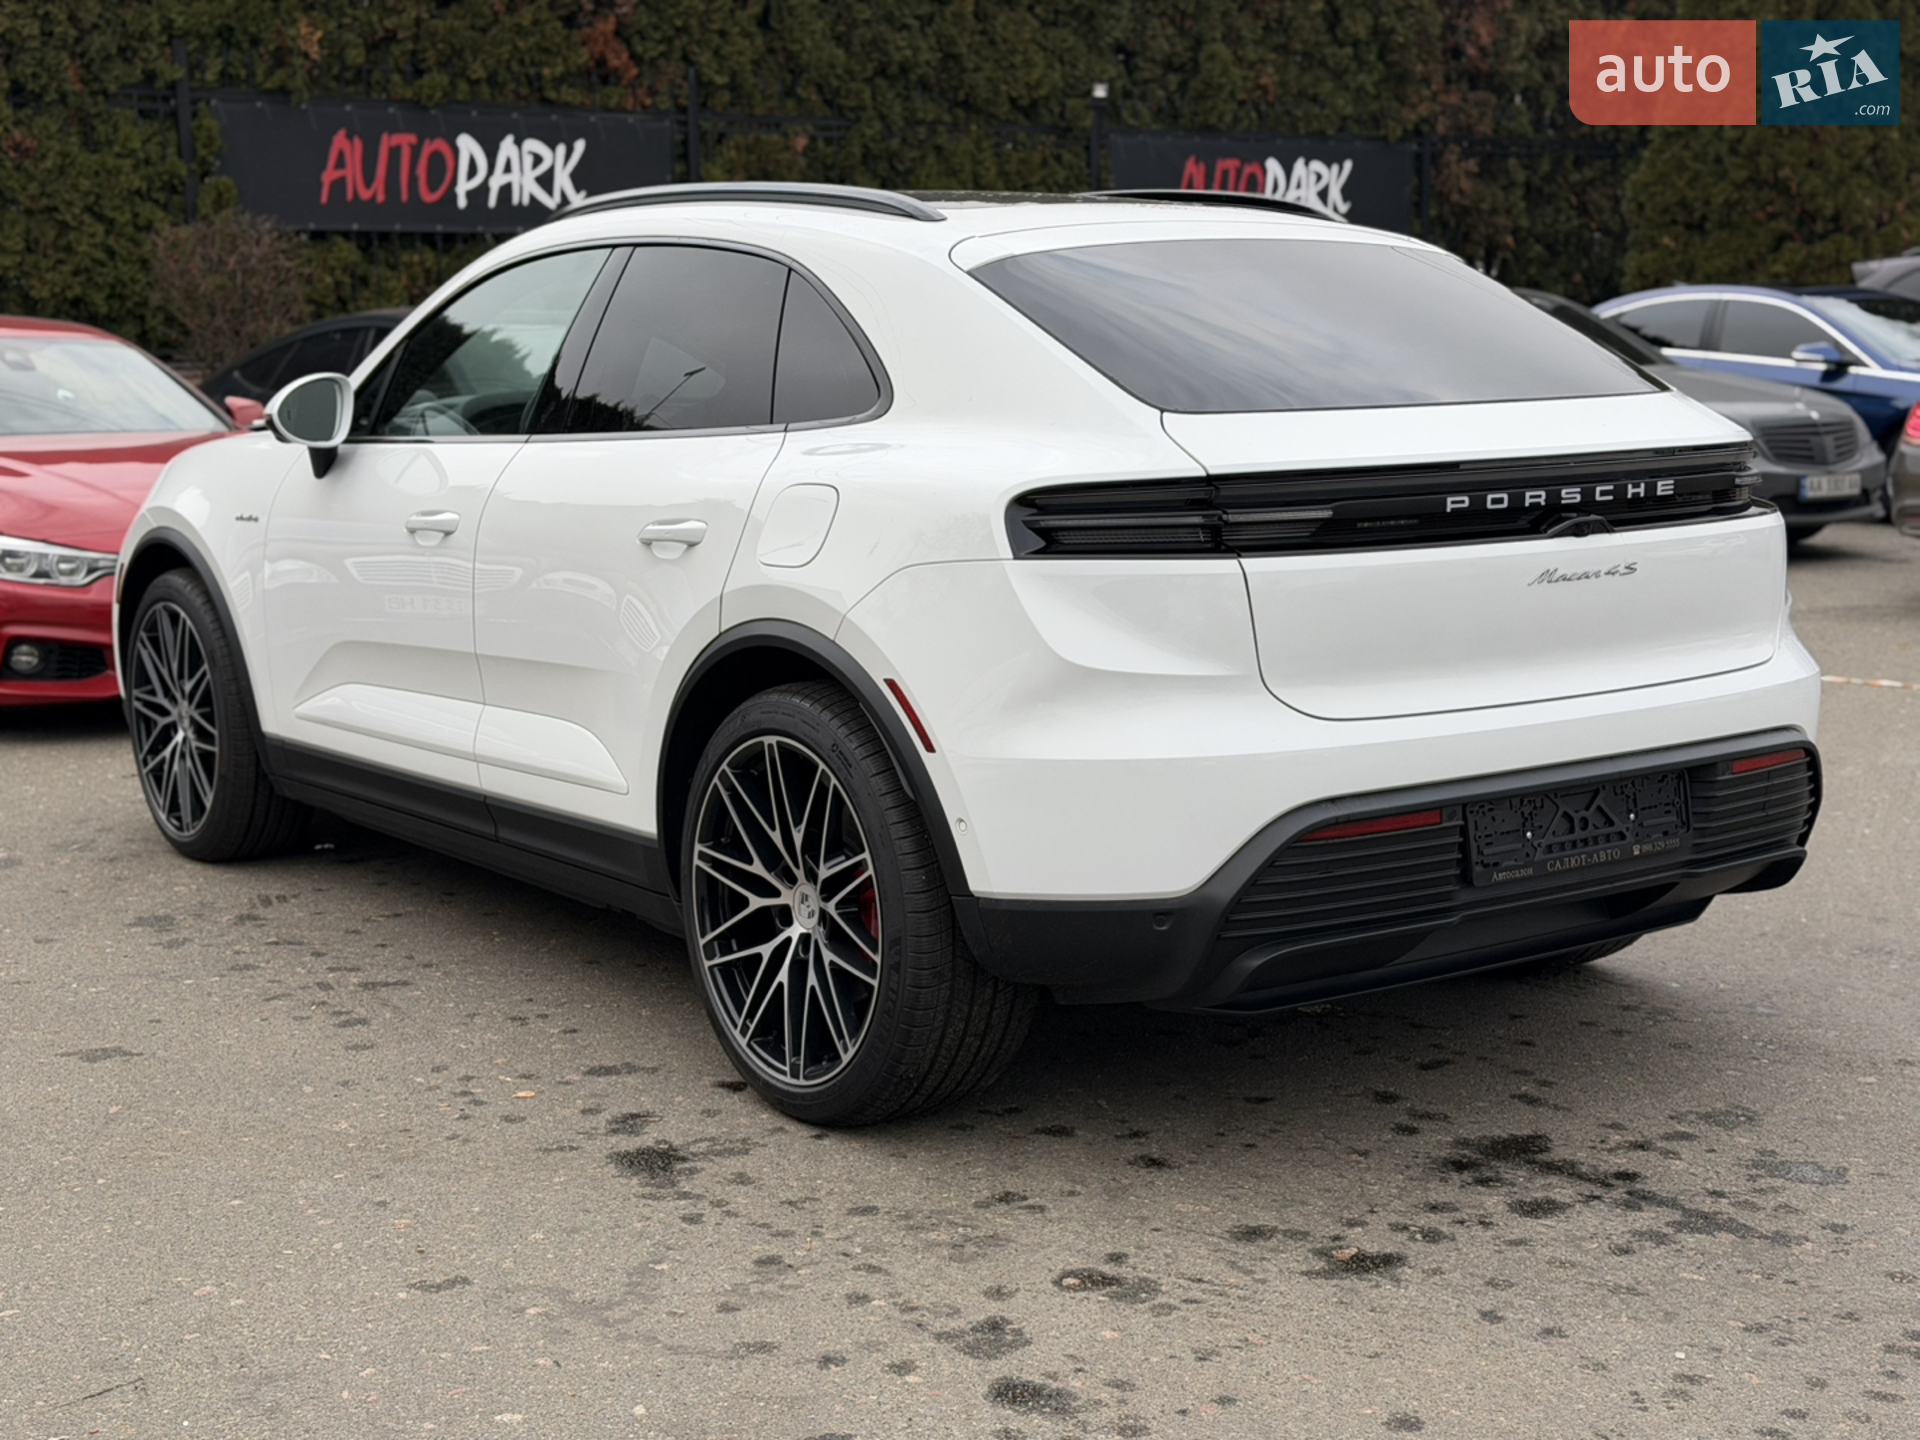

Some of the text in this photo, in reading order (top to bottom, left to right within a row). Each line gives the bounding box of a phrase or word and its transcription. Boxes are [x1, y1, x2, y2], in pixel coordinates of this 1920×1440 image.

[1445, 479, 1676, 513] PORSCHE
[1527, 561, 1639, 587] Macan 4S
[1546, 847, 1621, 872] САЛЮТ-АВТО
